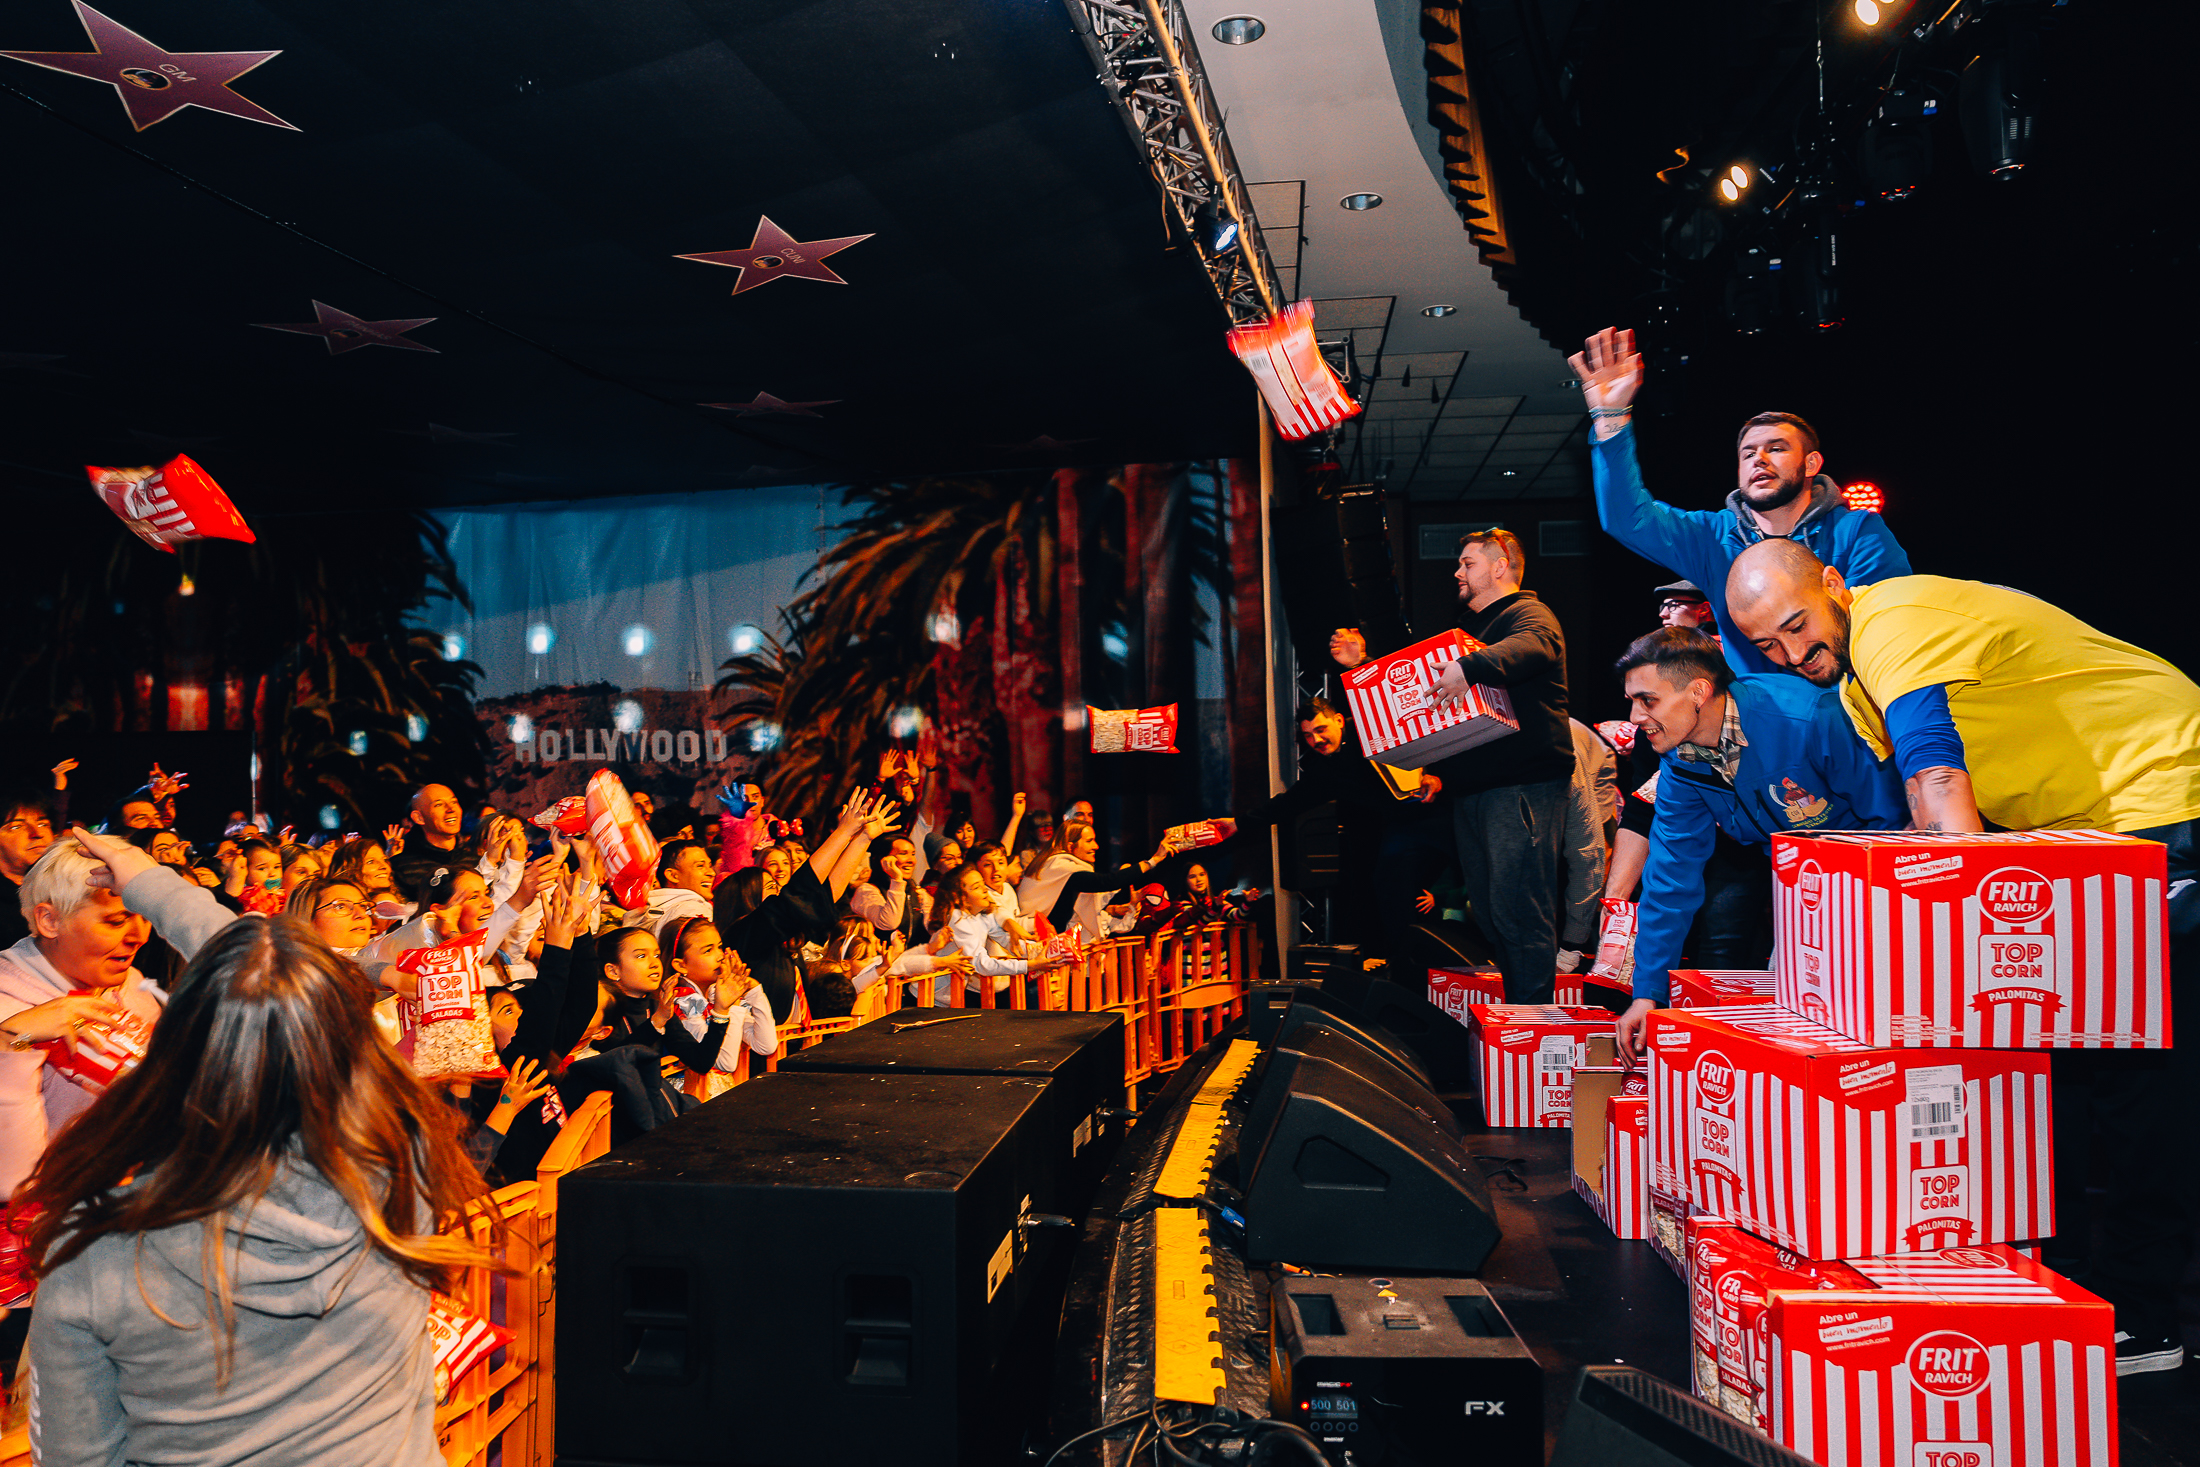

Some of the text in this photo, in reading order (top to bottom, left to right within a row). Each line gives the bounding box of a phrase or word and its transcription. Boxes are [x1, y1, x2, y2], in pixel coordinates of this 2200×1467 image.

[159, 64, 197, 82] GM
[1389, 663, 1411, 679] FRIT
[1397, 689, 1419, 703] TOP
[1400, 698, 1422, 710] CORN
[1143, 726, 1152, 746] TOP
[514, 727, 728, 763] HOLLYWOOD
[1894, 852, 1932, 865] Abre un
[1897, 859, 1959, 877] buen momento
[1988, 881, 2045, 902] FRIT
[1993, 902, 2038, 912] RAVICH
[427, 947, 454, 960] FRIT
[1990, 942, 2043, 963] TOP
[1990, 964, 2043, 978] CORN
[427, 975, 463, 991] TOP
[427, 989, 463, 1002] CORN
[1987, 989, 2046, 1002] PALOMITAS
[430, 1009, 464, 1020] SALADAS
[1700, 1060, 1732, 1086] FRIT
[1840, 1059, 1871, 1074] Abre un
[1548, 1089, 1571, 1100] TOP
[1702, 1080, 1727, 1096] RAVICH
[1701, 1116, 1730, 1143] TOP
[1701, 1136, 1730, 1159] CORN
[1919, 1174, 1961, 1195] TOP
[1919, 1194, 1960, 1211] CORN
[1917, 1220, 1962, 1234] PALOMITAS
[1721, 1276, 1741, 1296] FR
[1819, 1311, 1859, 1325] Abre un
[1717, 1320, 1740, 1347] TO
[1822, 1317, 1890, 1339] buen momento
[1825, 1336, 1891, 1352] www.fritravich.com
[1719, 1341, 1743, 1366] COR
[1918, 1347, 1981, 1372] FRIT
[1721, 1370, 1752, 1393] SALADAS
[1924, 1372, 1974, 1384] RAVICH
[1311, 1399, 1356, 1411] 500 501
[1464, 1401, 1505, 1416] FX
[1925, 1451, 1982, 1467] TOP
